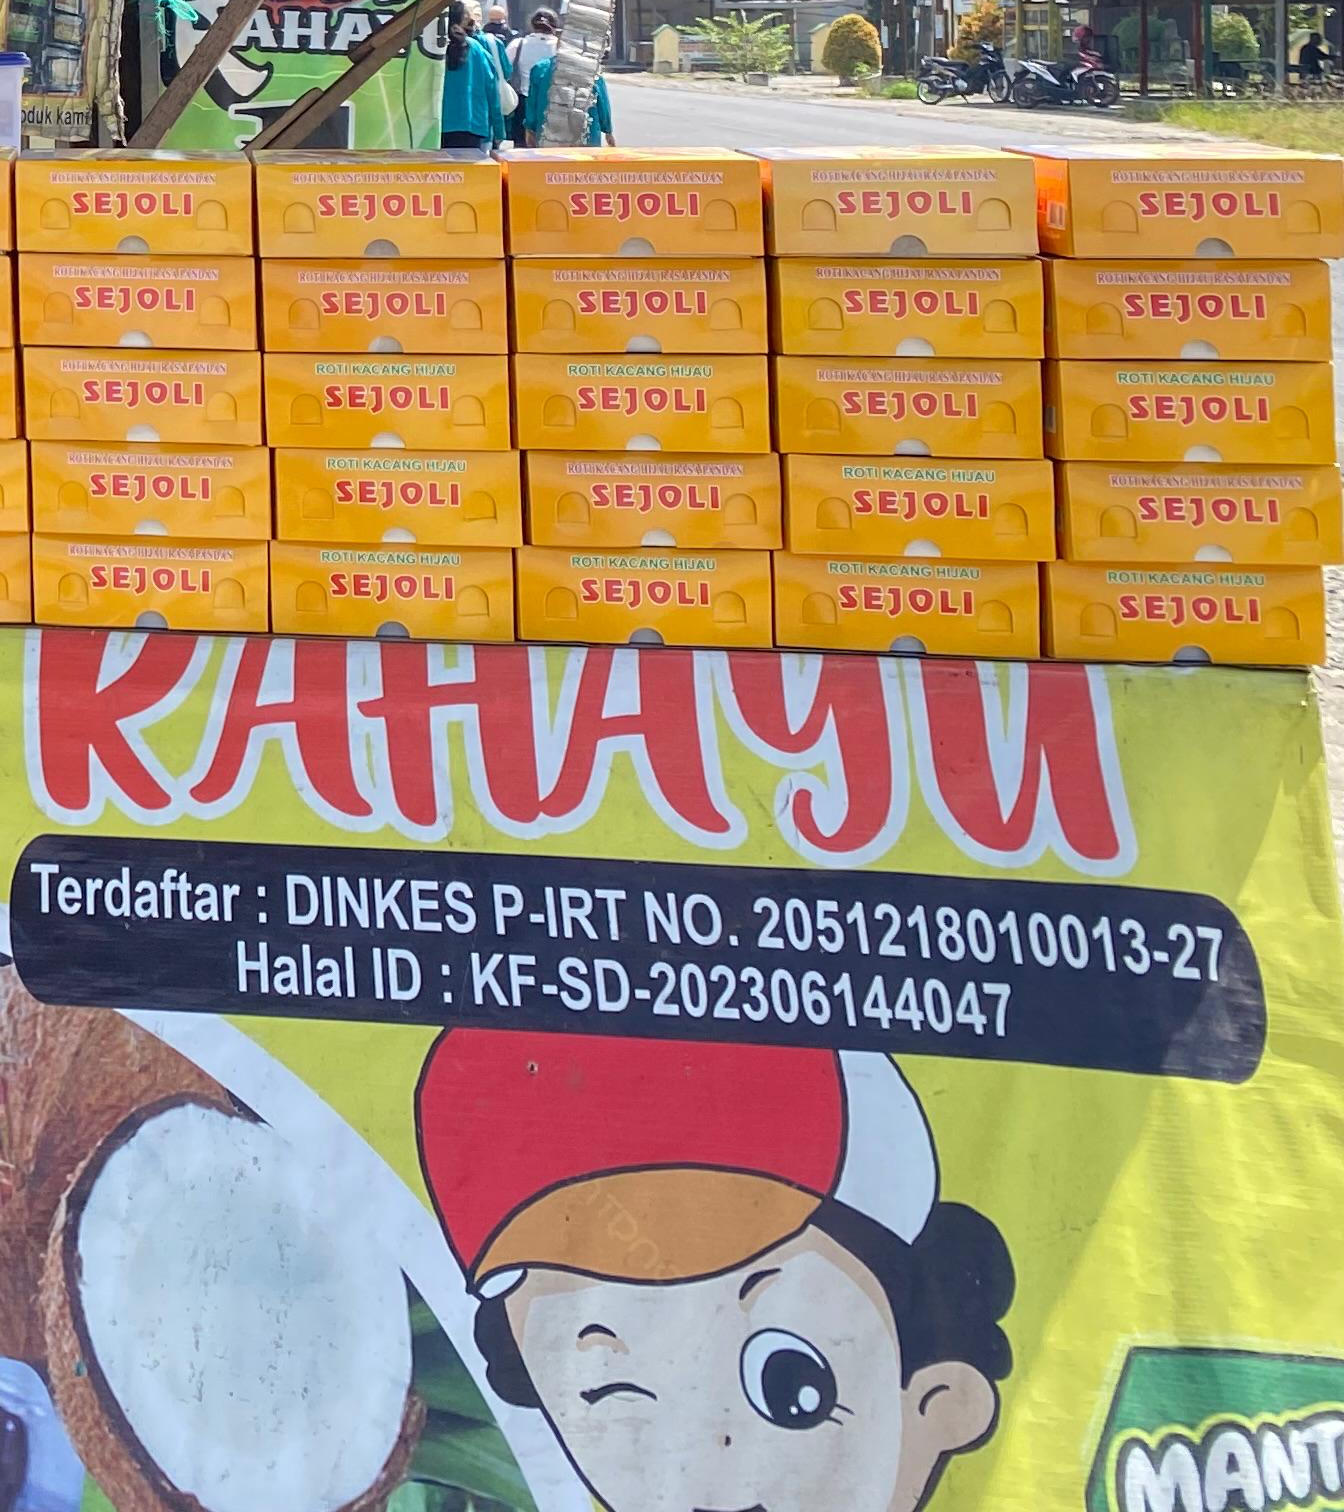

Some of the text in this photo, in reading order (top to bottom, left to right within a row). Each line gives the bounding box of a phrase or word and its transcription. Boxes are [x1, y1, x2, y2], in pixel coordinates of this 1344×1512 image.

[72, 191, 193, 218] SEJOLI
[318, 194, 443, 221] SEJOLI
[568, 190, 700, 222] SEJOLI
[837, 190, 973, 218] SEJOLI
[1138, 191, 1280, 221] SEJOLI
[75, 285, 195, 314] SEJOLI
[321, 290, 446, 318] SEJOLI
[577, 289, 707, 319] SEJOLI
[844, 289, 978, 318] SEJOLI
[1124, 293, 1266, 324] SEJOLI
[316, 363, 456, 376] ROTI KACANG HIJAU
[1117, 372, 1275, 386] ROTI KACANG HIJAU
[83, 379, 204, 409] SEJOLI
[326, 384, 450, 413] SEJOLI
[577, 386, 705, 415] SEJOLI
[843, 390, 977, 420] SEJOLI
[1129, 394, 1268, 426] SEJOLI
[90, 473, 210, 501] SEJOLI
[335, 480, 460, 508] SEJOLI
[590, 482, 721, 512] SEJOLI
[853, 490, 988, 521] SEJOLI
[1138, 495, 1278, 526] SEJOLI
[91, 565, 210, 593] SEJOLI
[330, 572, 454, 602] SEJOLI
[582, 578, 709, 608] SEJOLI
[839, 584, 973, 617] SEJOLI
[1118, 594, 1258, 626] SEJOLI
[30, 861, 1225, 985] Terdaftar DINKES P-IRT NO. 2051218010013-27
[235, 940, 1013, 1040] Halal ID KF-SD-202306144047
